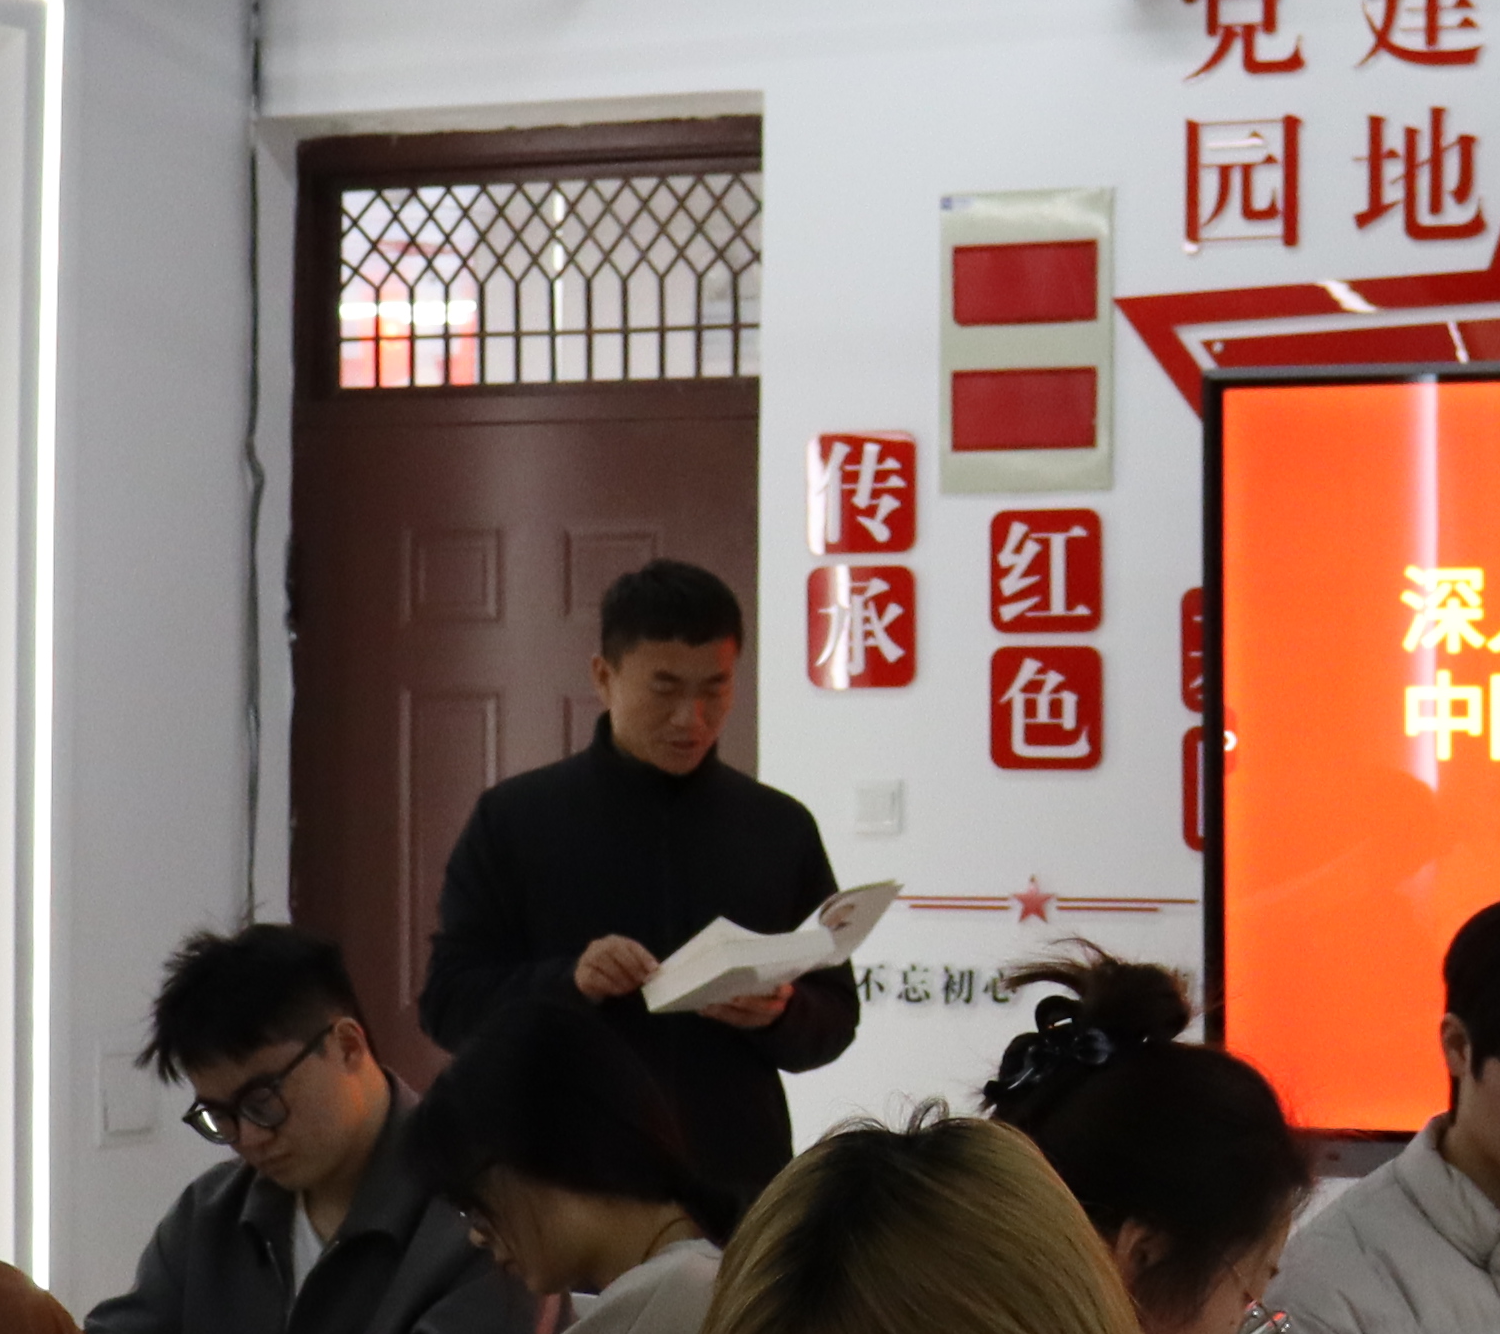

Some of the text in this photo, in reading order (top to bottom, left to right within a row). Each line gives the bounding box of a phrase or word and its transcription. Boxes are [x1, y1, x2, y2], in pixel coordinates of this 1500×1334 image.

[1182, 105, 1489, 253] 园地
[817, 441, 906, 675] 传承
[996, 522, 1091, 758] 红色
[857, 966, 1016, 1006] 不忘初心
